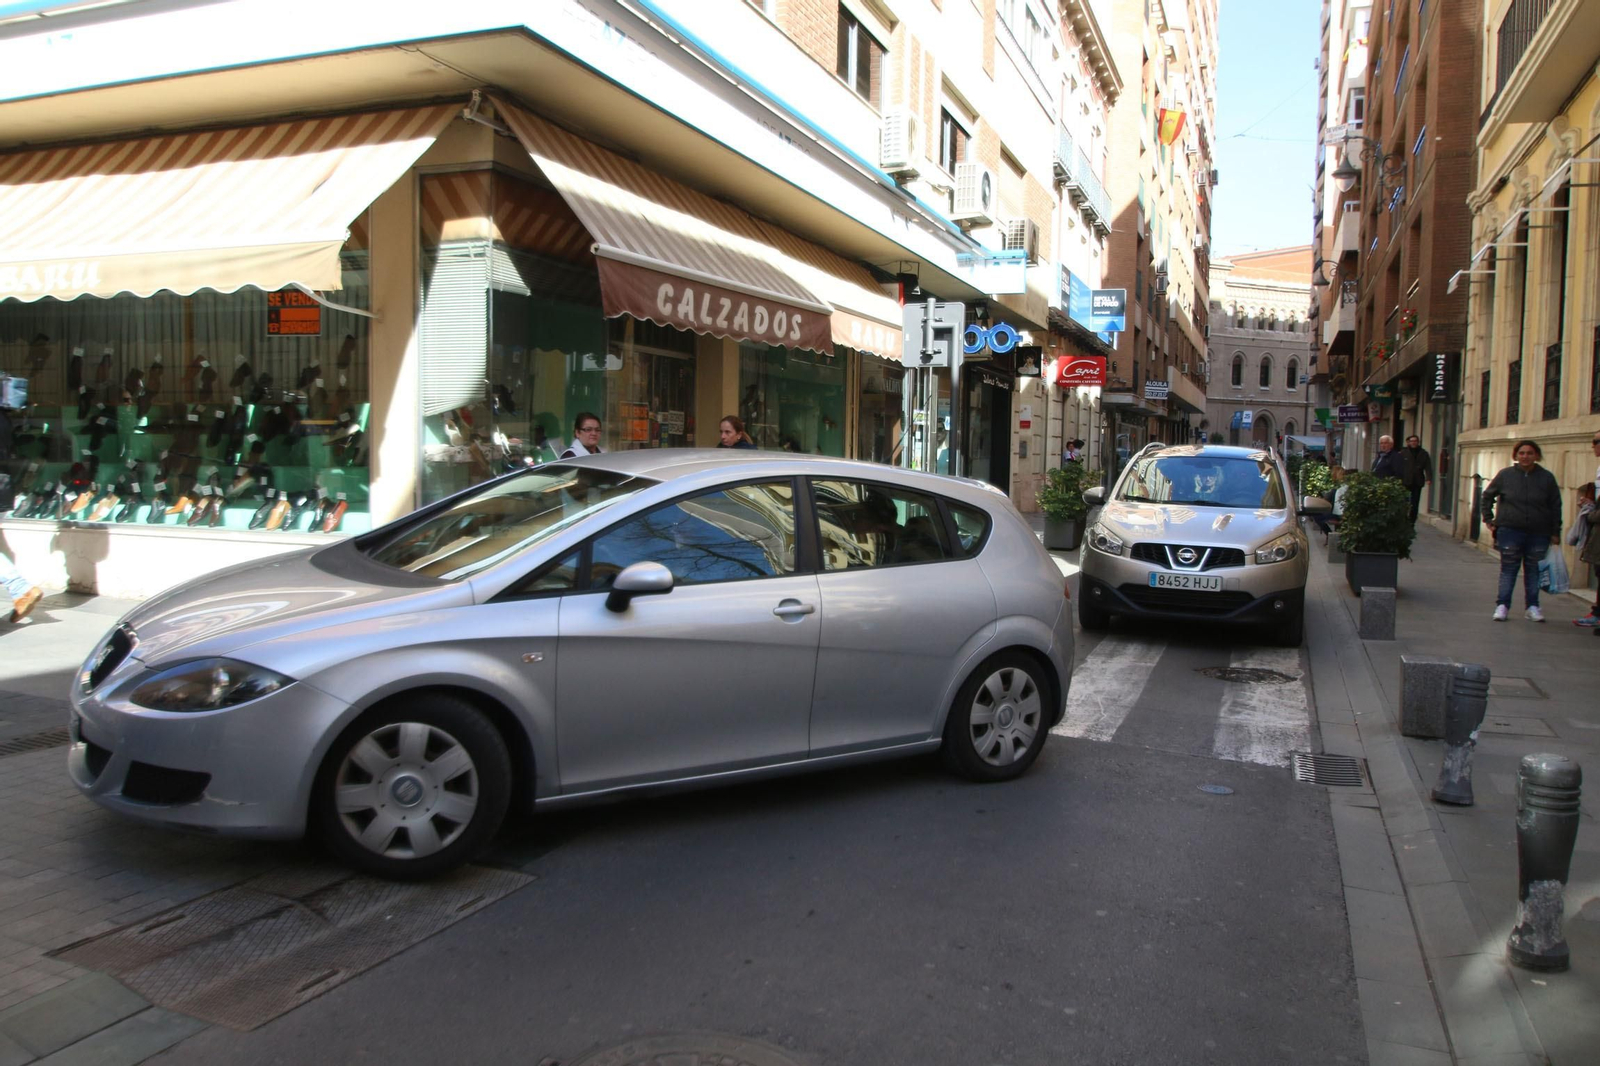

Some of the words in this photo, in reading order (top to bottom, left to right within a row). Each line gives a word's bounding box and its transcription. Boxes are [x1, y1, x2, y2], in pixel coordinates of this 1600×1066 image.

[267, 292, 282, 307] SE
[656, 282, 802, 341] CALZADOS
[1062, 359, 1100, 377] Capri
[1435, 354, 1446, 391] NATACHA
[1158, 574, 1190, 588] 8452
[1193, 577, 1218, 589] HJJ
